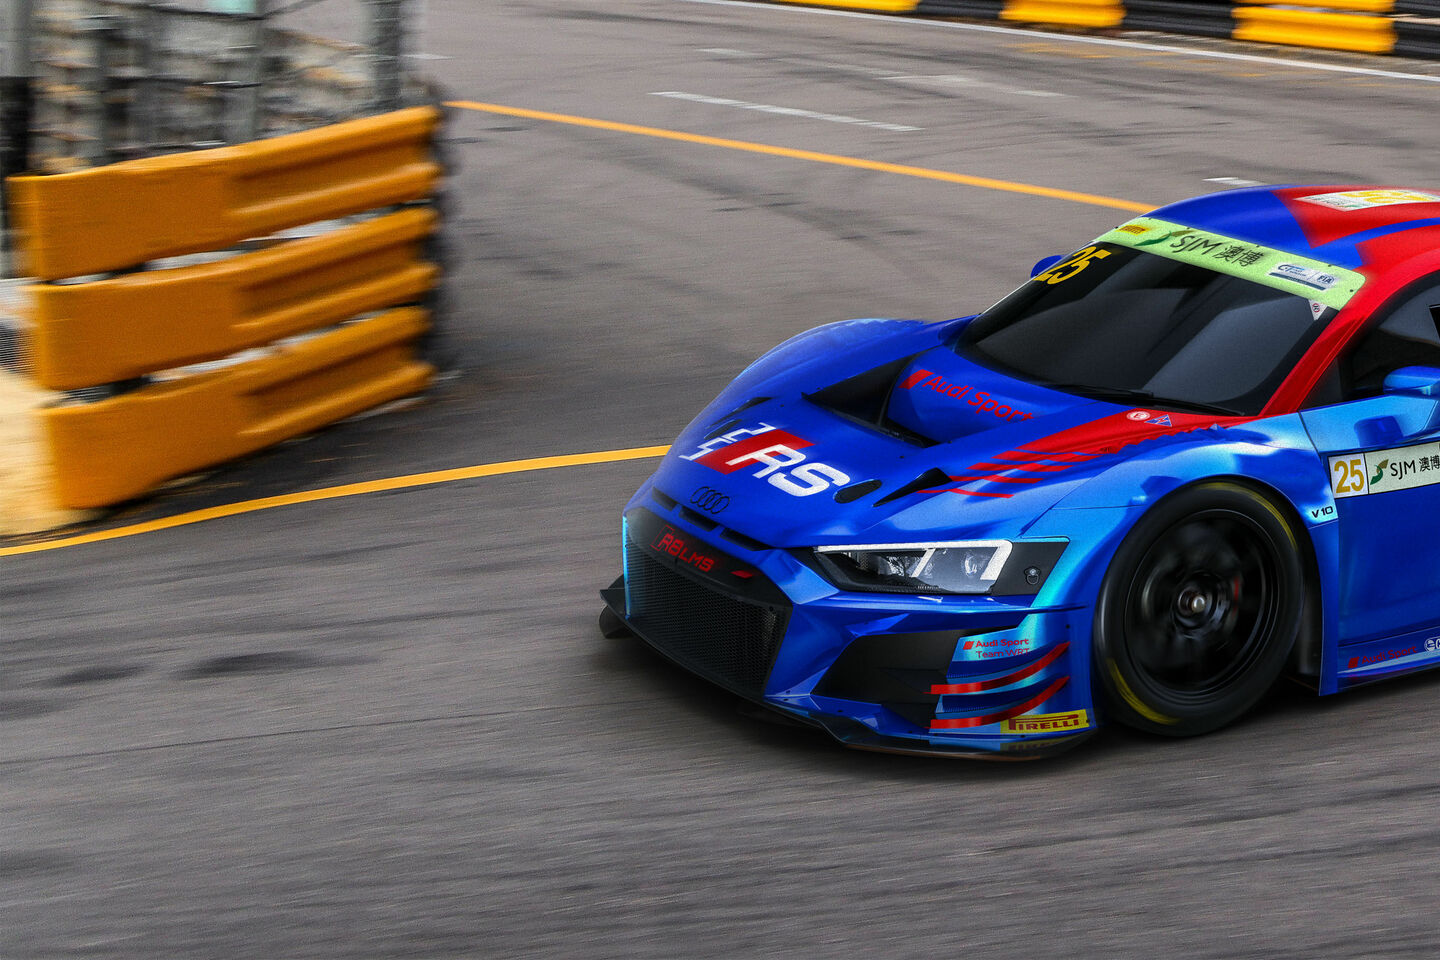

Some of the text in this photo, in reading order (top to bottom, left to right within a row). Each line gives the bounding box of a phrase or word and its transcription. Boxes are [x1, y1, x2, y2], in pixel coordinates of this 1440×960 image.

[1033, 246, 1112, 285] 25
[1169, 235, 1265, 268] SJM 澳博
[921, 375, 1034, 421] Audi Sport
[724, 443, 851, 497] RS
[1333, 458, 1365, 494] 25
[1390, 454, 1440, 480] SJM 澳博
[975, 638, 1030, 648] Audi Sport
[975, 648, 1030, 659] Team WRT
[1361, 646, 1417, 664] Audi Sport
[1008, 713, 1080, 731] PIRELLI
